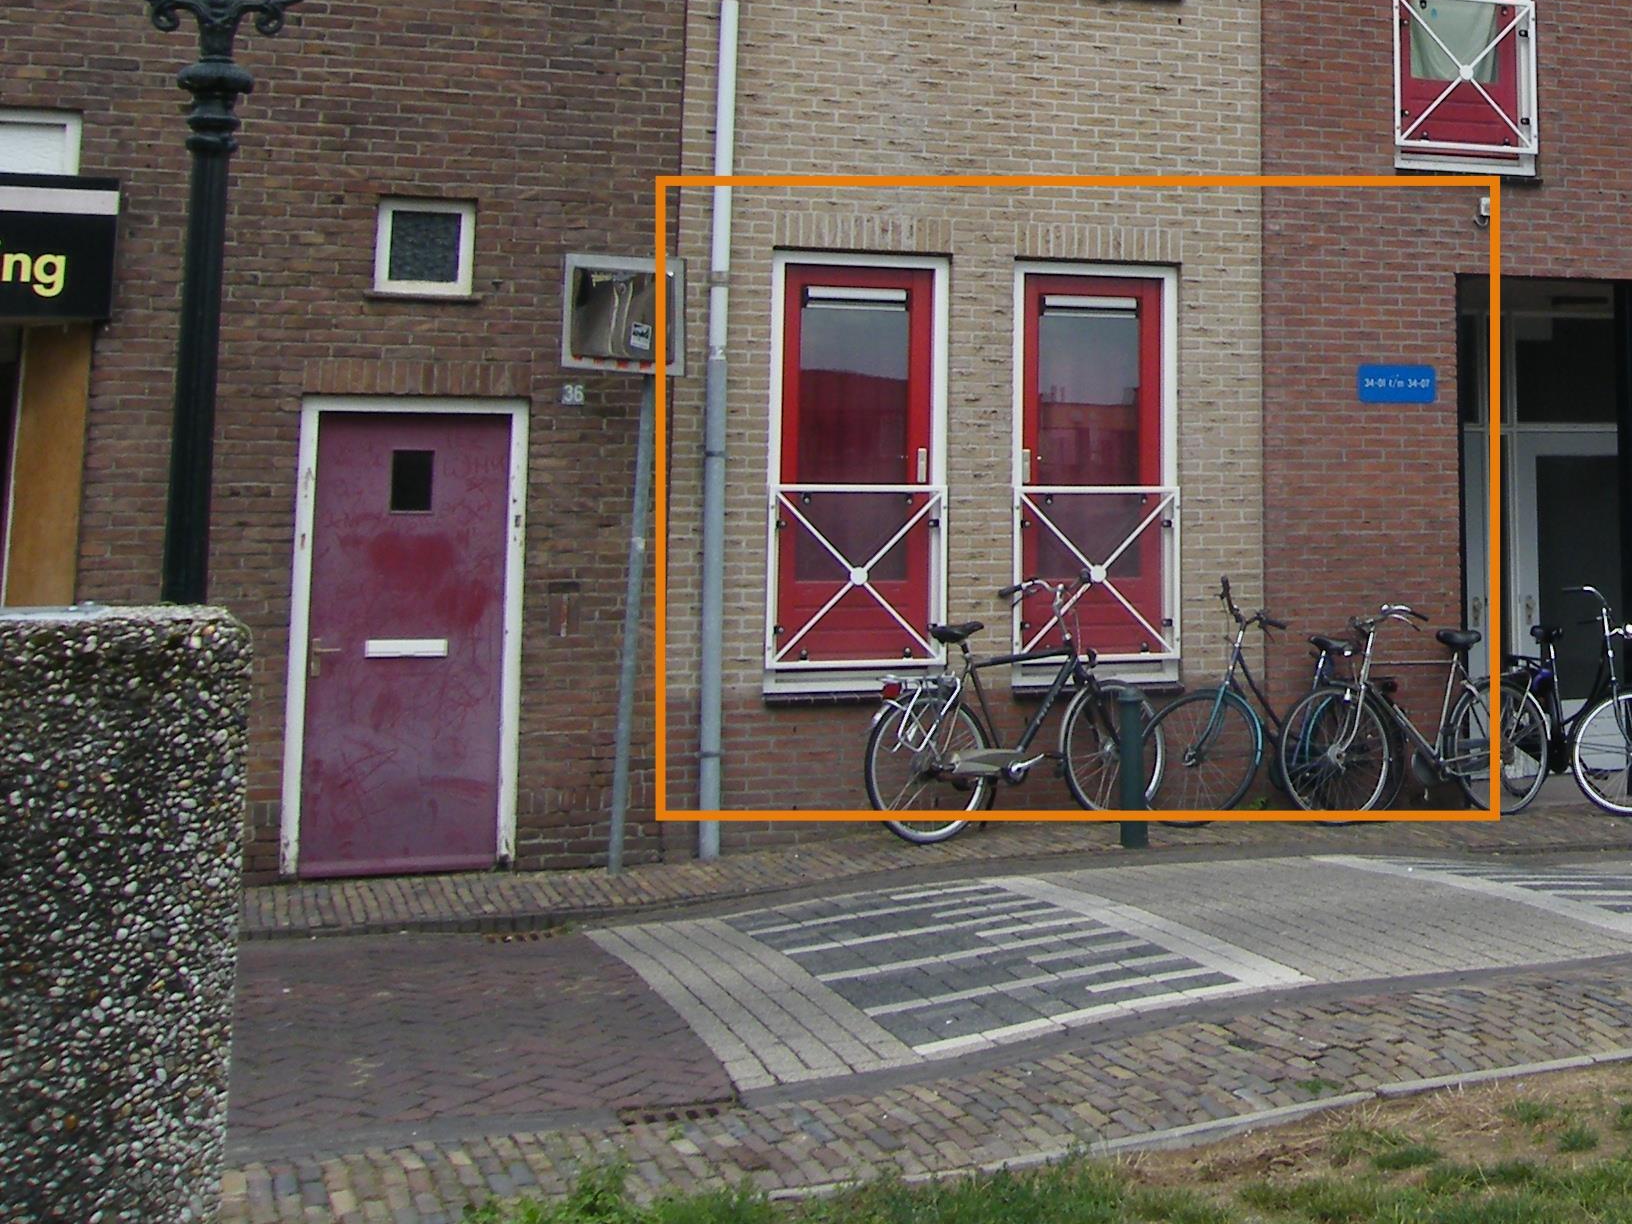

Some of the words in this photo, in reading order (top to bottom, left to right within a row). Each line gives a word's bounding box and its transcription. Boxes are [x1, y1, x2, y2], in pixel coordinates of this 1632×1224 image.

[0, 240, 67, 297] ng
[1388, 378, 1405, 388] t/m
[562, 384, 584, 402] 36
